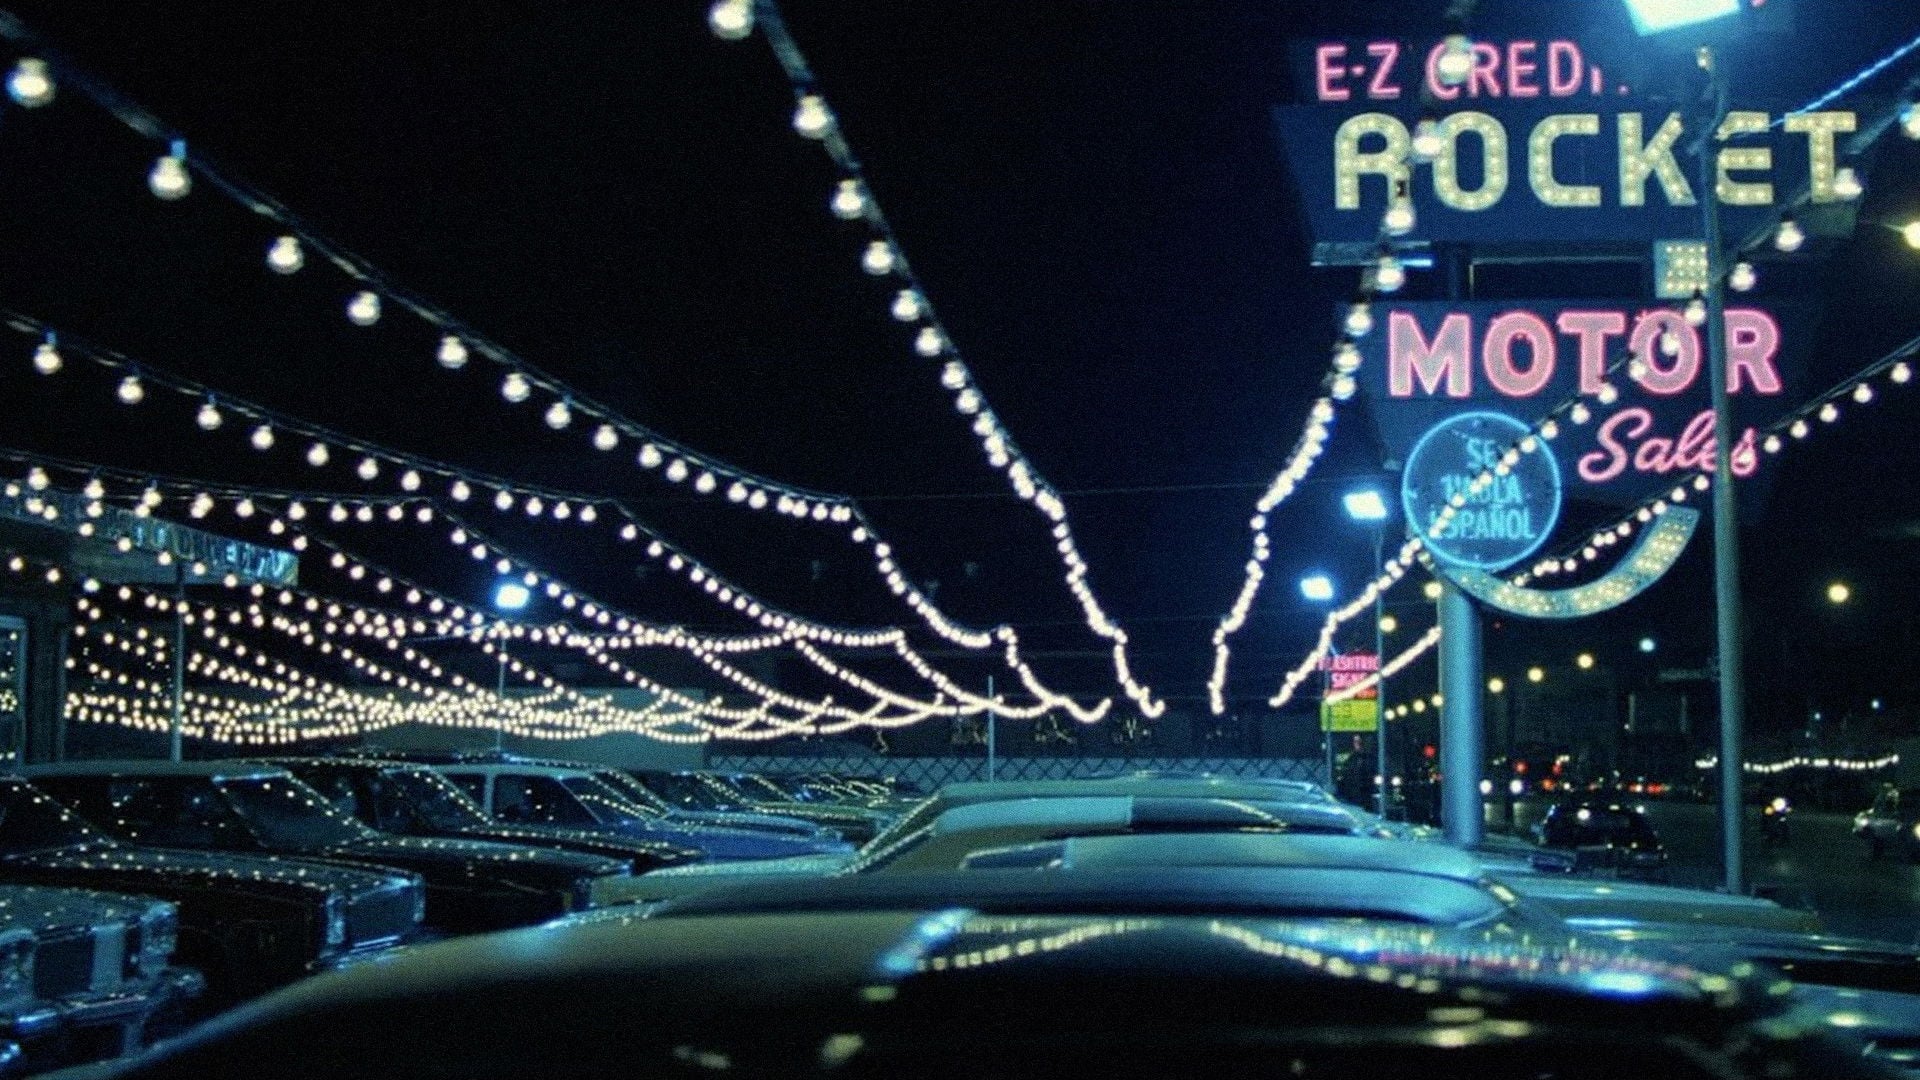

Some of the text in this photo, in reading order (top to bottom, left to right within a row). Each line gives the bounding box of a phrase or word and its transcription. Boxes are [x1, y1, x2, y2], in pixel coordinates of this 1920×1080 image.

[1424, 40, 1629, 99] CREDI
[1334, 111, 1857, 211] ROCKET
[1388, 309, 1782, 398] MOTOR
[1577, 406, 1758, 483] Sales
